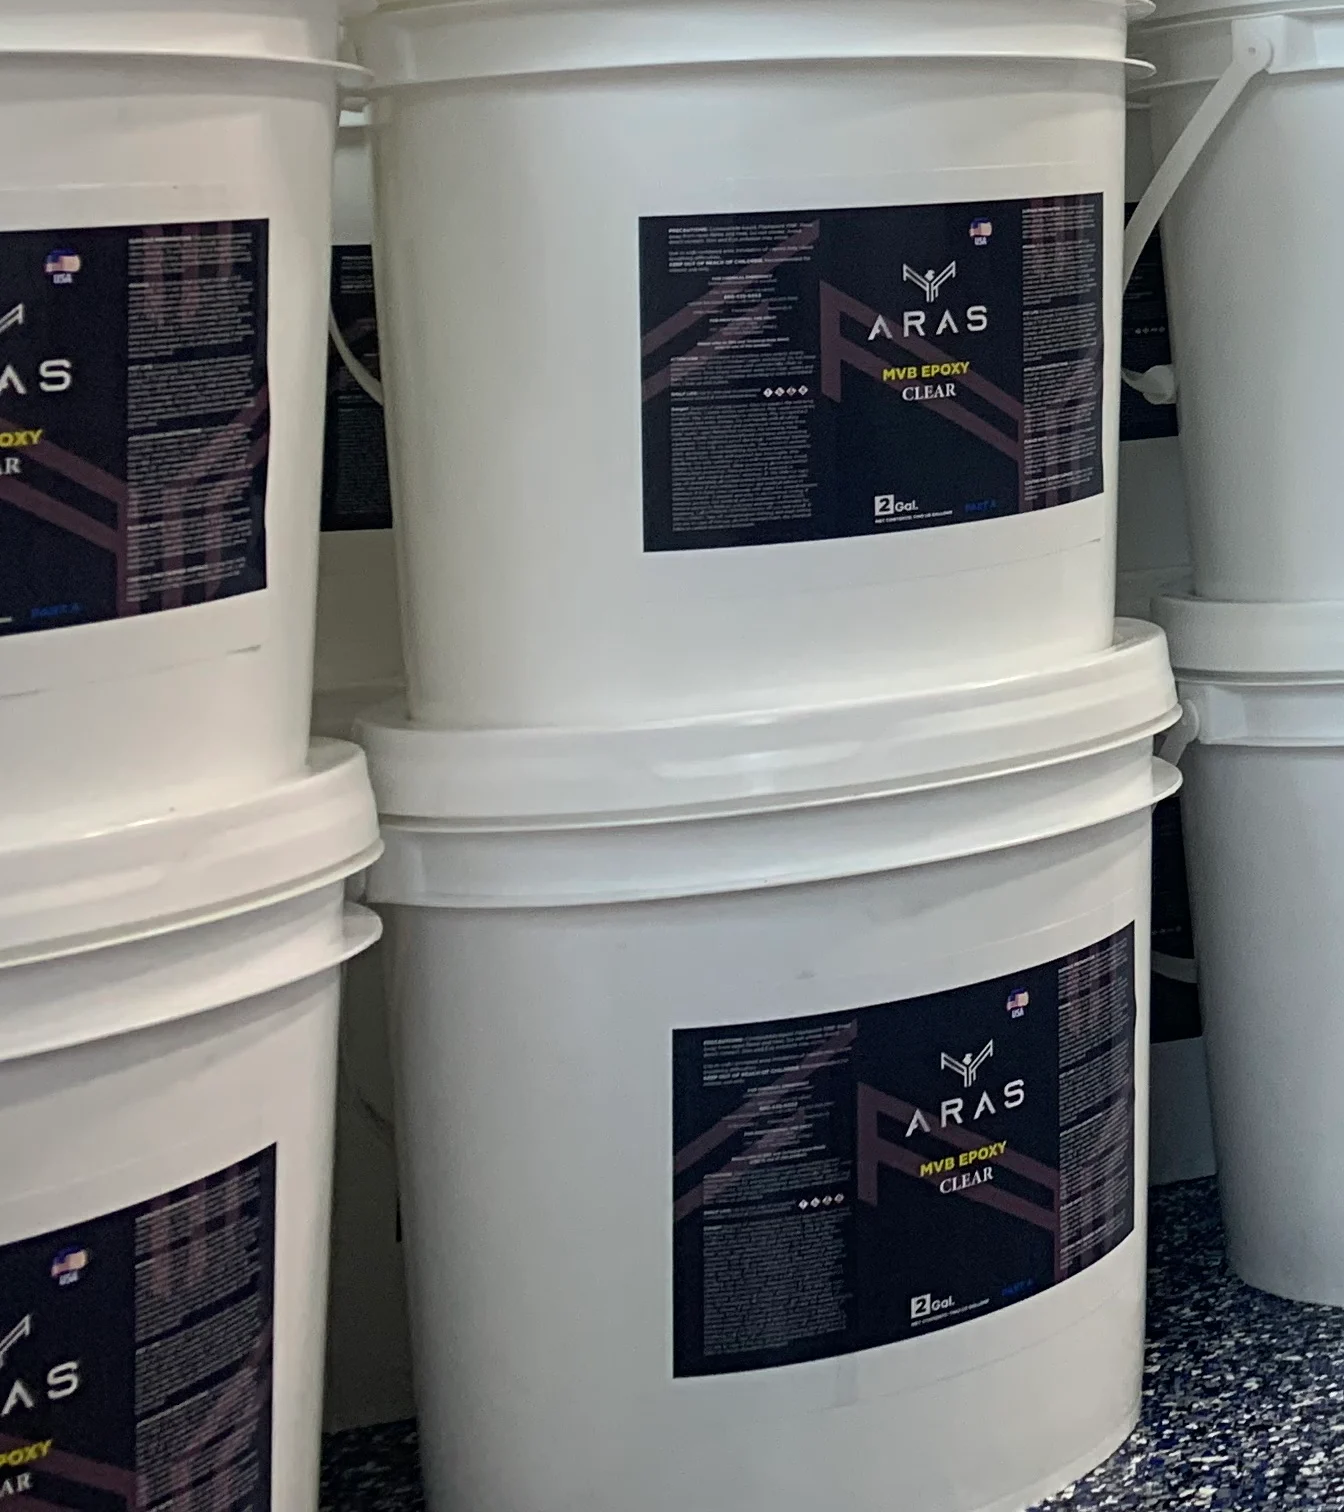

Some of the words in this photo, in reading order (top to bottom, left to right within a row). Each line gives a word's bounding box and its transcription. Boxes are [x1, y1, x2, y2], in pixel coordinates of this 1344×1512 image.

[868, 305, 988, 340] ARAS
[0, 359, 72, 395] AS
[883, 367, 917, 382] MVB
[921, 361, 969, 378] EPOXY
[902, 383, 956, 401] CLEAR
[879, 497, 890, 512] 2
[895, 500, 919, 513] Gal.
[905, 1079, 1025, 1138] ARAS
[919, 1156, 955, 1177] MVB
[959, 1141, 1007, 1167] EPOXY
[939, 1166, 994, 1194] CLEAR
[915, 1297, 926, 1314] 2
[1, 1360, 80, 1416] AS
